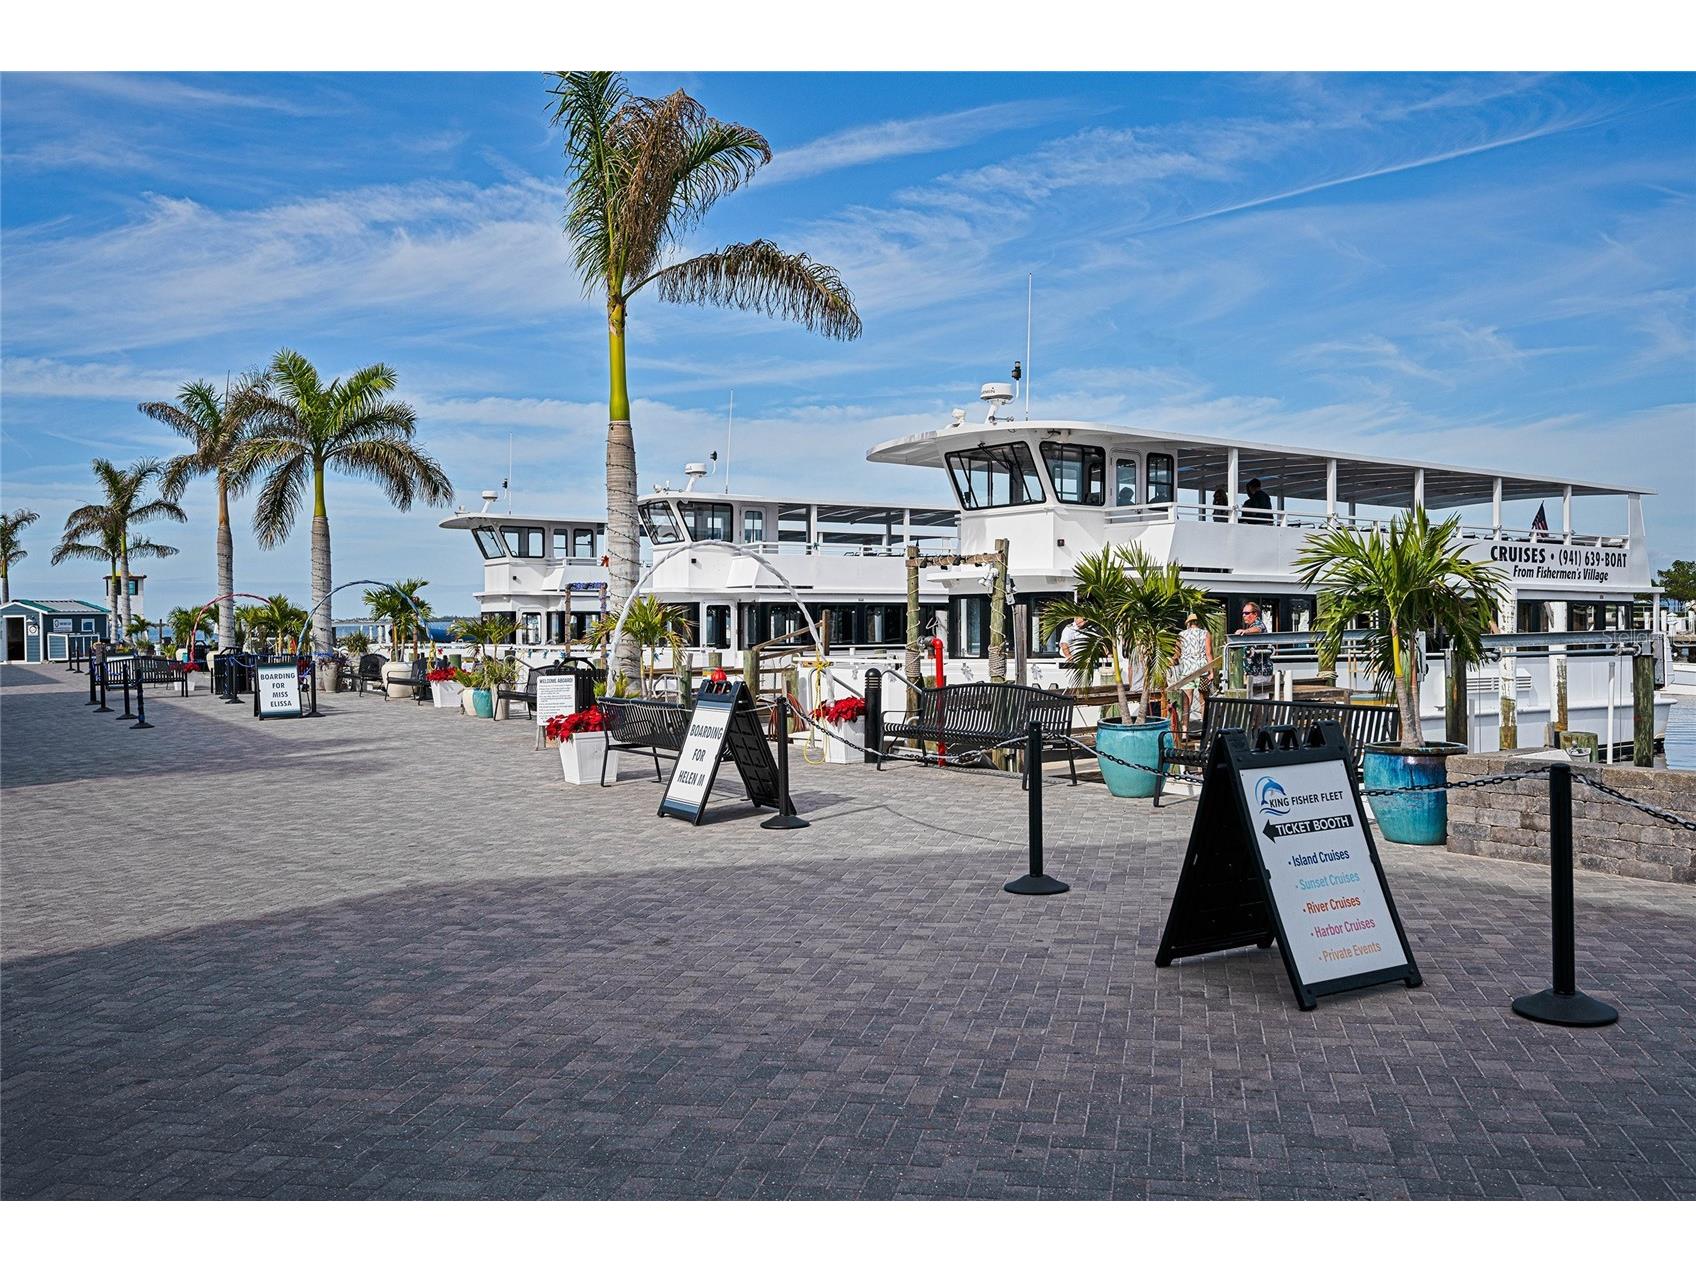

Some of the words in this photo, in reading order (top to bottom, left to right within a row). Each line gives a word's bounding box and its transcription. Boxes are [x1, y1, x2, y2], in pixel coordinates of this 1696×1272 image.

[1490, 545, 1546, 564] CRUISES
[1559, 549, 1582, 567] (941)
[1584, 551, 1627, 568] 639-BOAT
[1513, 565, 1534, 578] From
[1536, 566, 1581, 580] Fishermen's
[1583, 568, 1609, 583] Village
[690, 724, 723, 740] BOARDING
[692, 748, 706, 762] FOR
[677, 770, 699, 786] HELEN
[697, 774, 706, 787] M
[1269, 797, 1290, 808] KING
[1291, 793, 1319, 806] FISHER
[1320, 790, 1343, 802] FLEET
[1275, 821, 1313, 836] TICKET
[1312, 815, 1350, 831] BOOTH
[1292, 851, 1319, 867] Island
[1318, 849, 1350, 863] Cruises
[1299, 874, 1328, 891] Sunset
[1328, 871, 1360, 886] Cruises
[1306, 899, 1329, 914] River
[1329, 896, 1361, 911] Cruises
[1314, 922, 1343, 938] Harbor
[1344, 918, 1376, 933] Cruises
[1321, 947, 1353, 963] Private
[1352, 942, 1382, 957] Events
